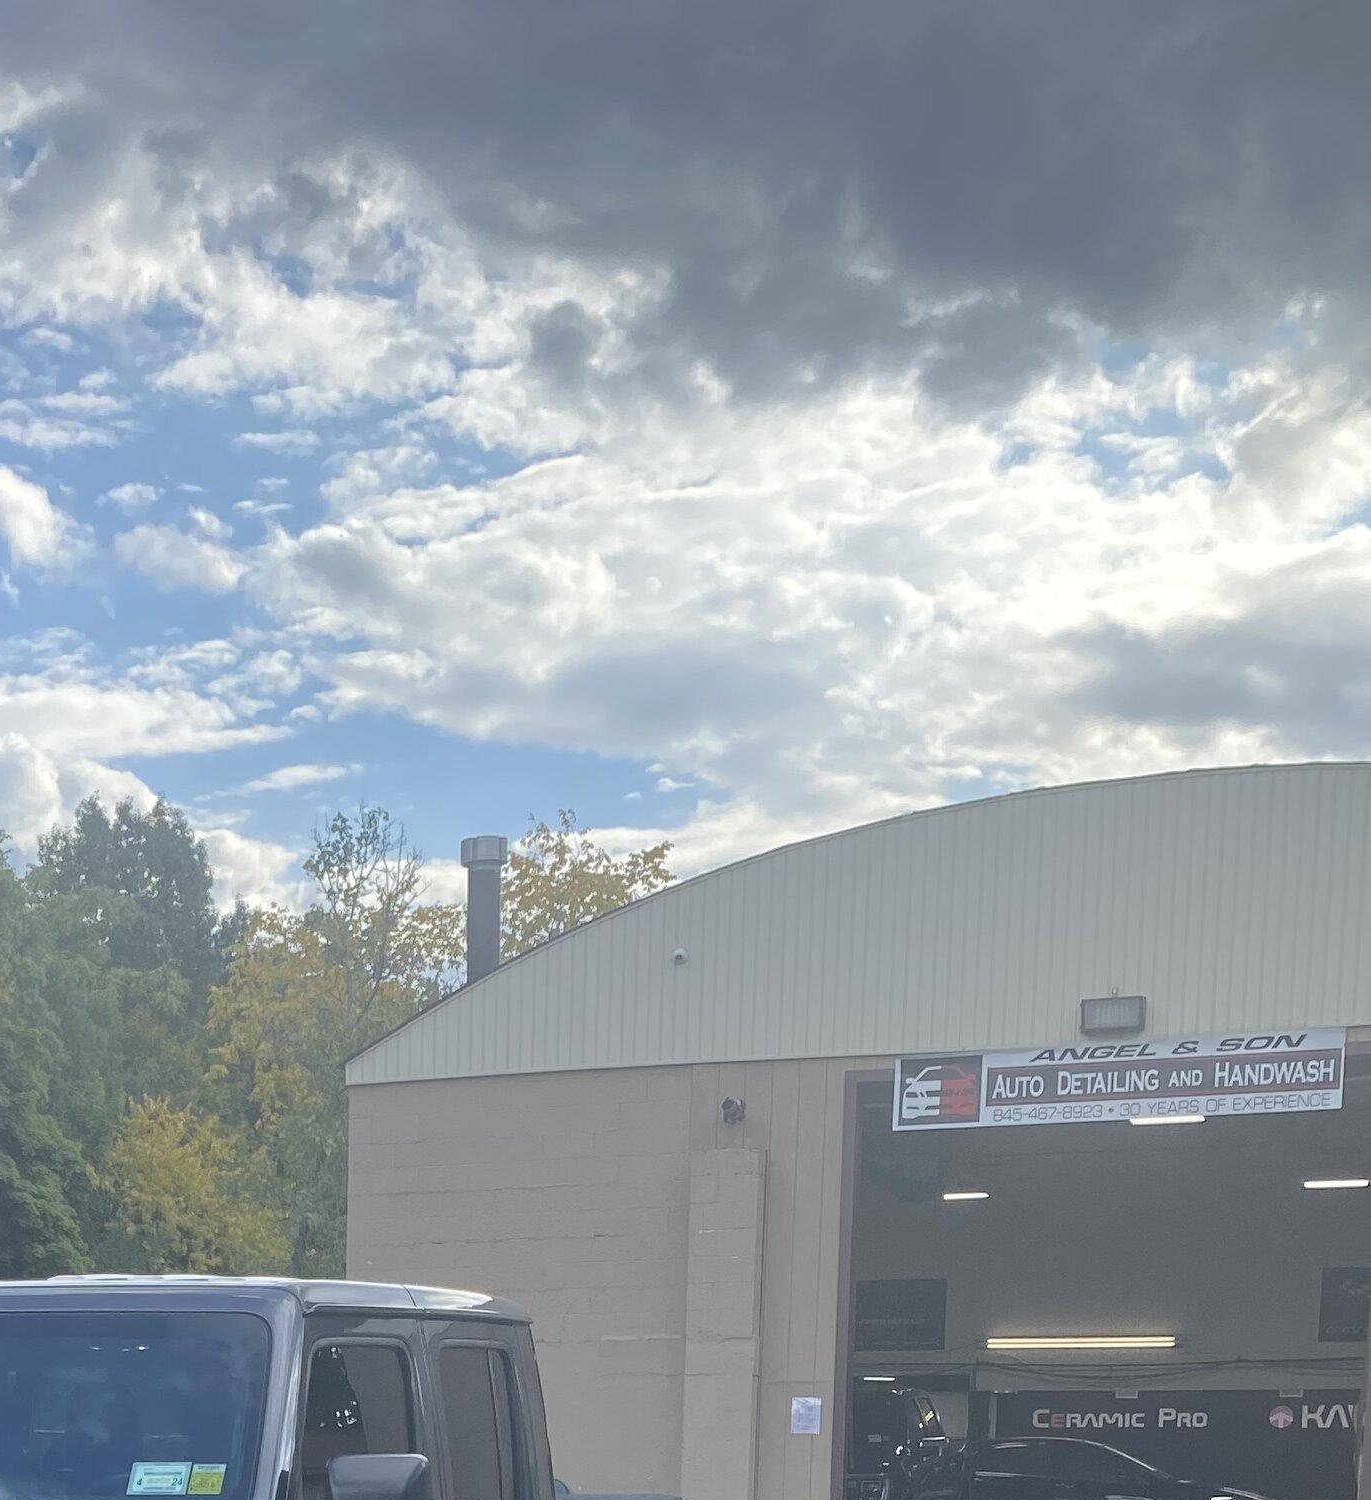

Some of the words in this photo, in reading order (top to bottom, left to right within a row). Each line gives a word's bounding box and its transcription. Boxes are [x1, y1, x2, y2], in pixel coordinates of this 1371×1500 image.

[1029, 1043, 1157, 1063] ANGEL
[1171, 1040, 1200, 1055] &
[1216, 1033, 1308, 1052] SON
[992, 1073, 1045, 1099] AUTO
[1056, 1069, 1160, 1096] DETAILING
[1168, 1069, 1203, 1088] AND
[1214, 1059, 1335, 1088] HANDWASH
[1119, 1102, 1141, 1117] 30
[1147, 1099, 1200, 1115] YEARS
[1205, 1097, 1228, 1113] OF
[1232, 1092, 1331, 1112] EXPERIENCE
[1032, 1408, 1146, 1428] CERAMIC
[1158, 1407, 1208, 1428] PRO
